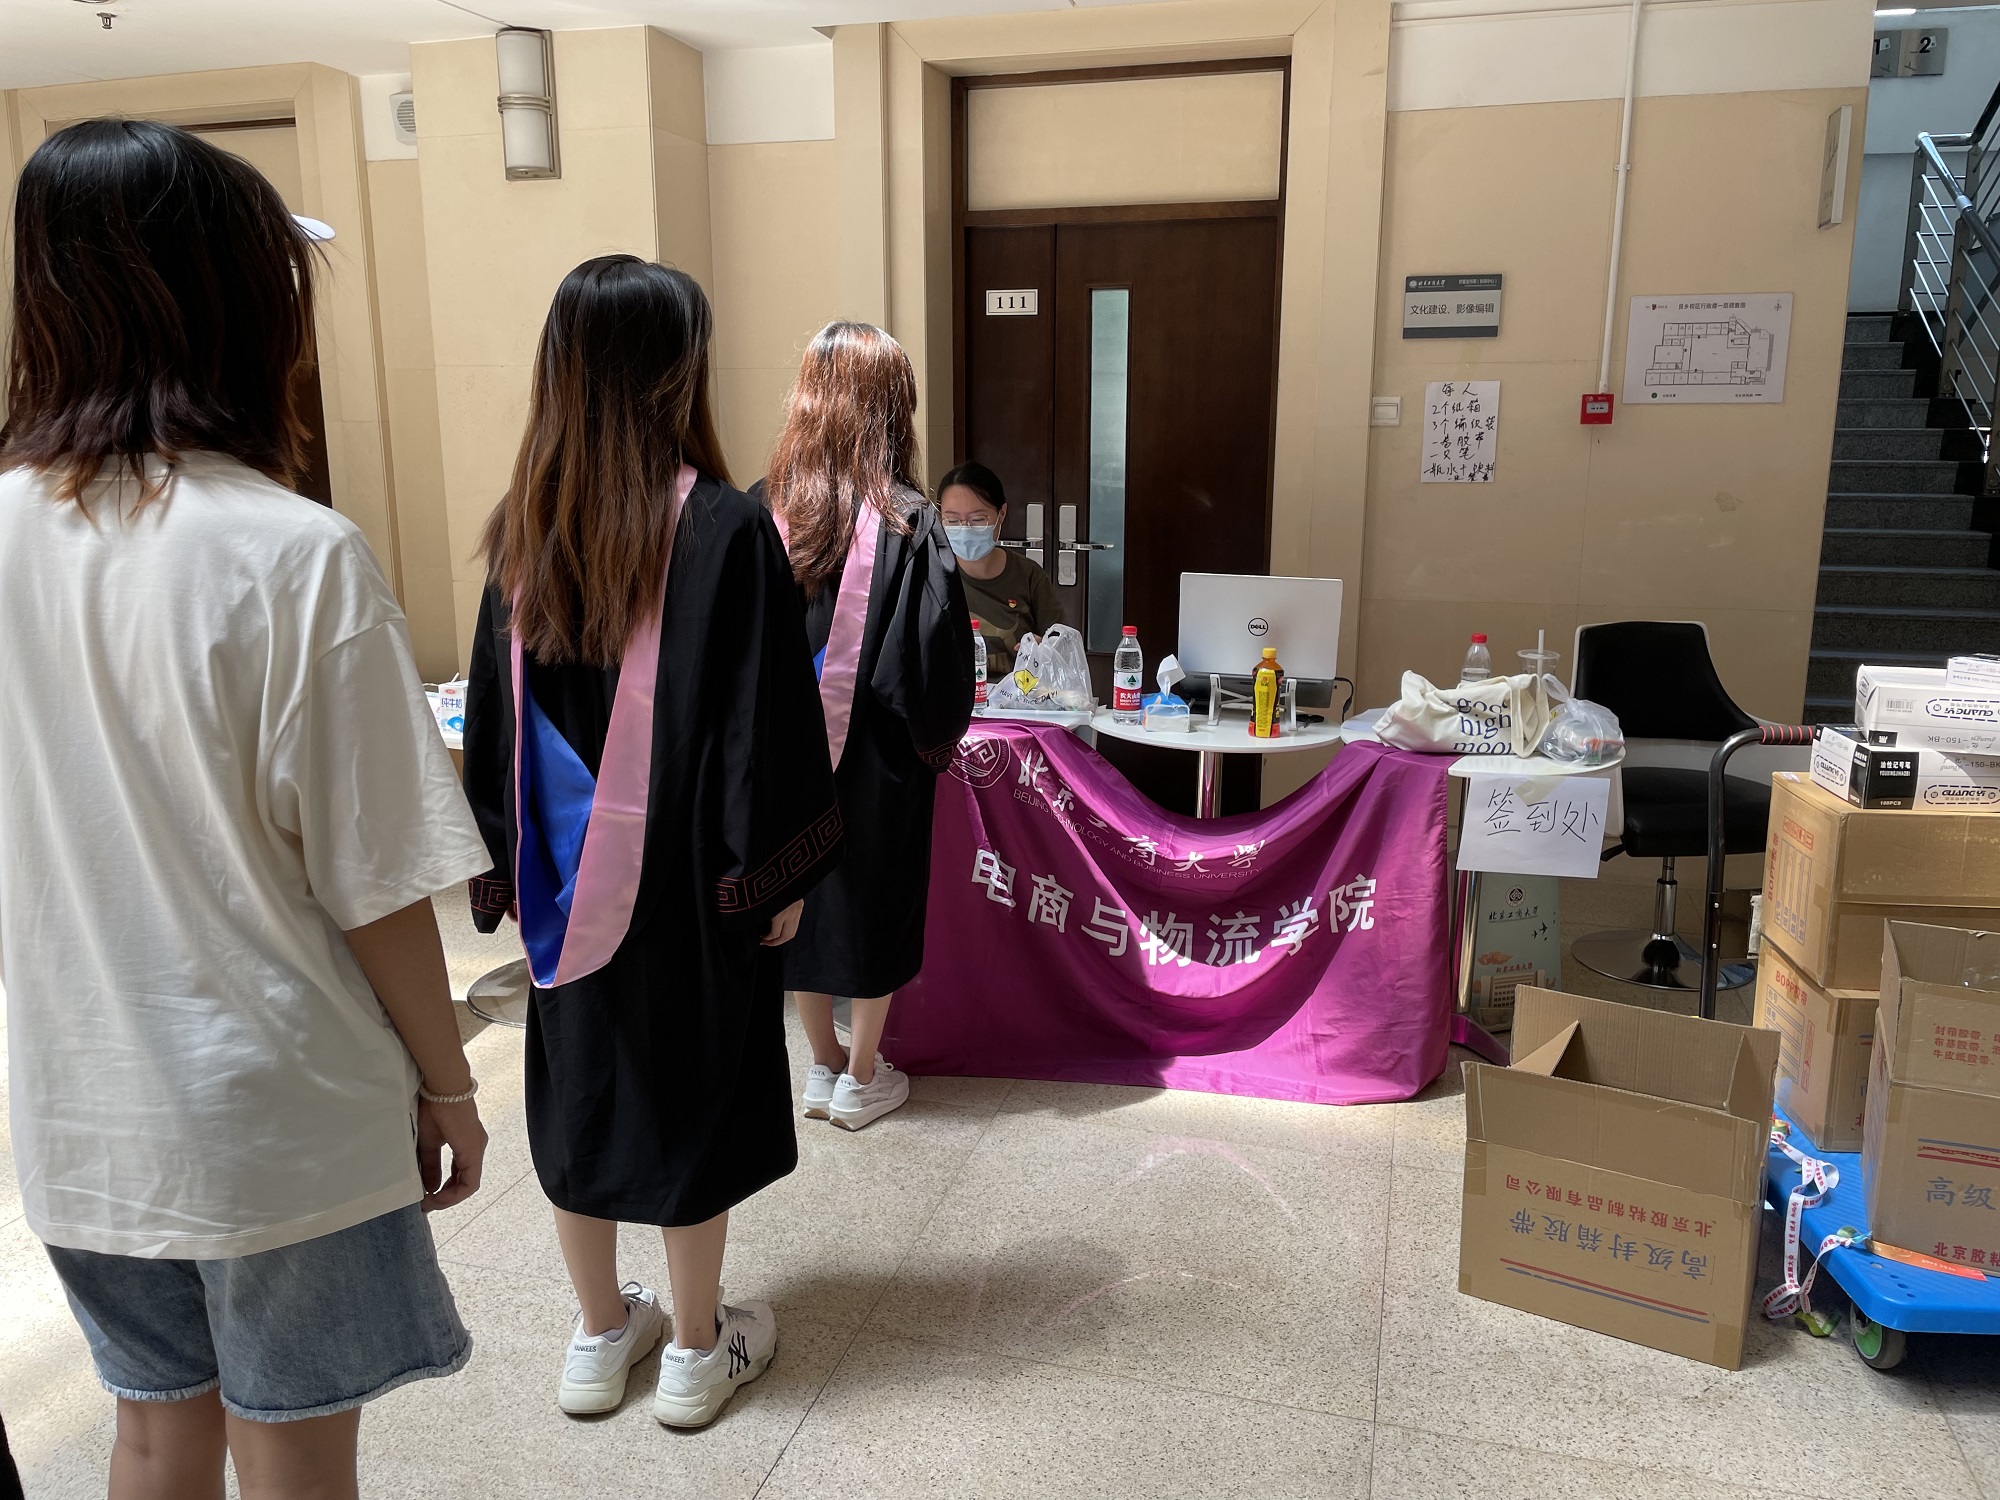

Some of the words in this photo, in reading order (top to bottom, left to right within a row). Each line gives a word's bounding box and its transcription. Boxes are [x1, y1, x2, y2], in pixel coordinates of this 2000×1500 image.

[1919, 36, 1932, 54] 2
[997, 296, 1027, 309] 111
[1410, 303, 1495, 315] 文化建设、影像编辑
[1460, 713, 1512, 739] high
[1484, 787, 1599, 843] 签到处
[1013, 789, 1049, 813] BEIJING
[1050, 809, 1109, 848] TECHNOLOGY
[1109, 847, 1132, 863] AND
[1133, 860, 1191, 879] BUSINESS
[1193, 866, 1263, 880] UNIVERSITY
[971, 848, 1377, 967] 电商与物流学院
[1505, 1174, 1713, 1238] 北京胶粘制品有限公司
[1926, 1176, 1997, 1211] 高级
[1508, 1207, 1708, 1280] 高级封箱胶带
[573, 1345, 597, 1353] YANKEES
